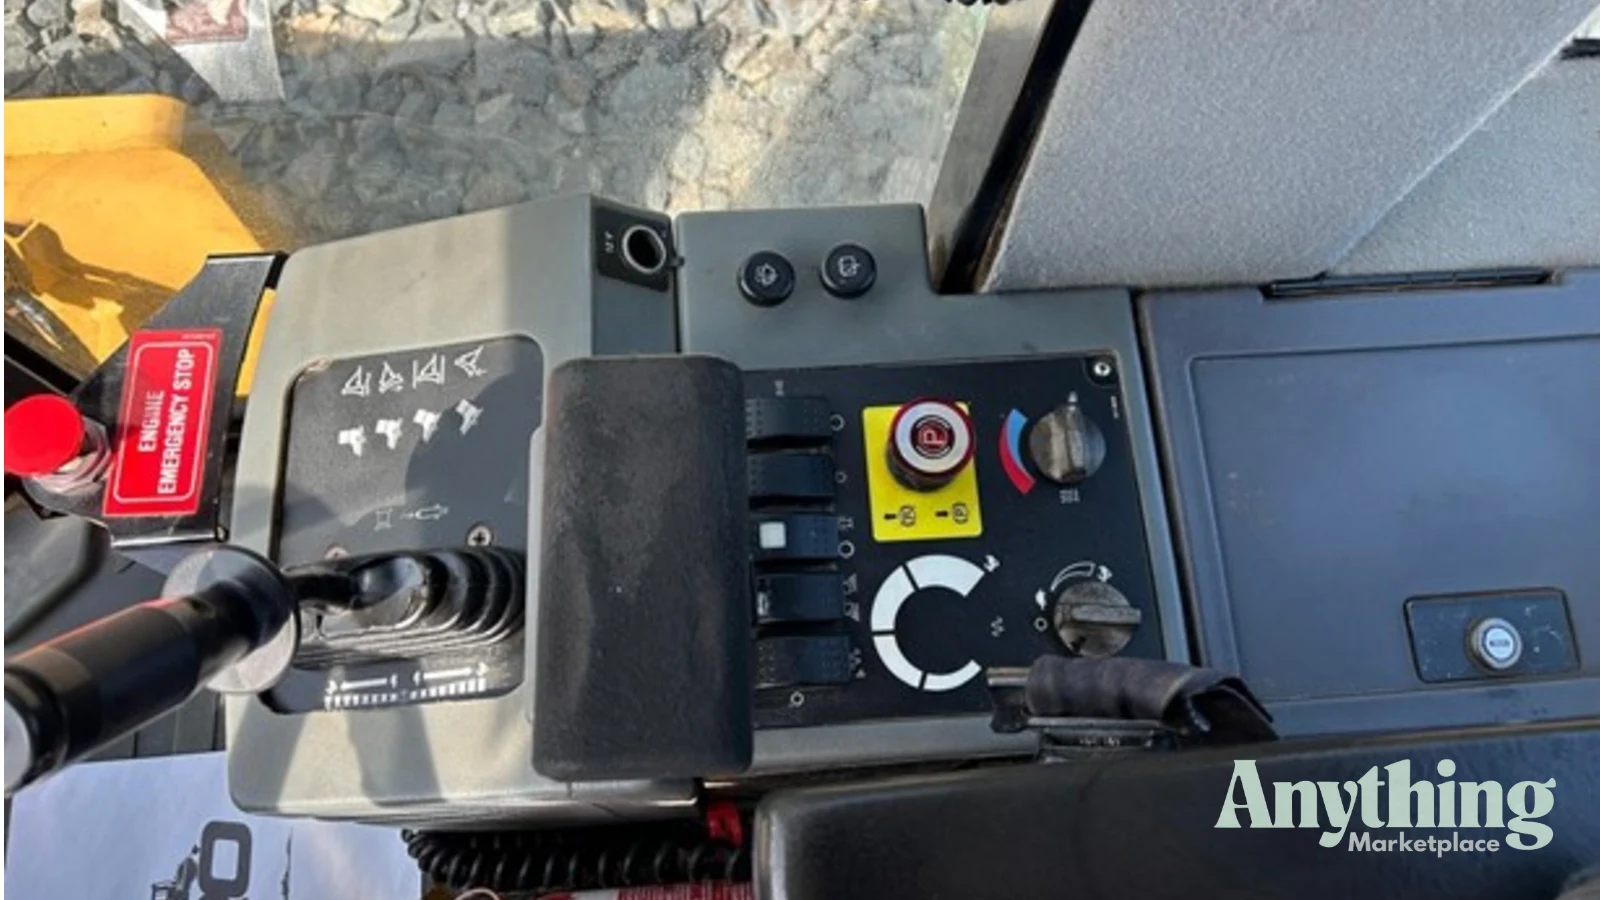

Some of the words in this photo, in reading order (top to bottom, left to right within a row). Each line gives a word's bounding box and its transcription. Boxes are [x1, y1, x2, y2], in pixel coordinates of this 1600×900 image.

[172, 348, 197, 390] STOP
[138, 390, 165, 452] ENGINE
[157, 394, 189, 494] EMERGENCY
